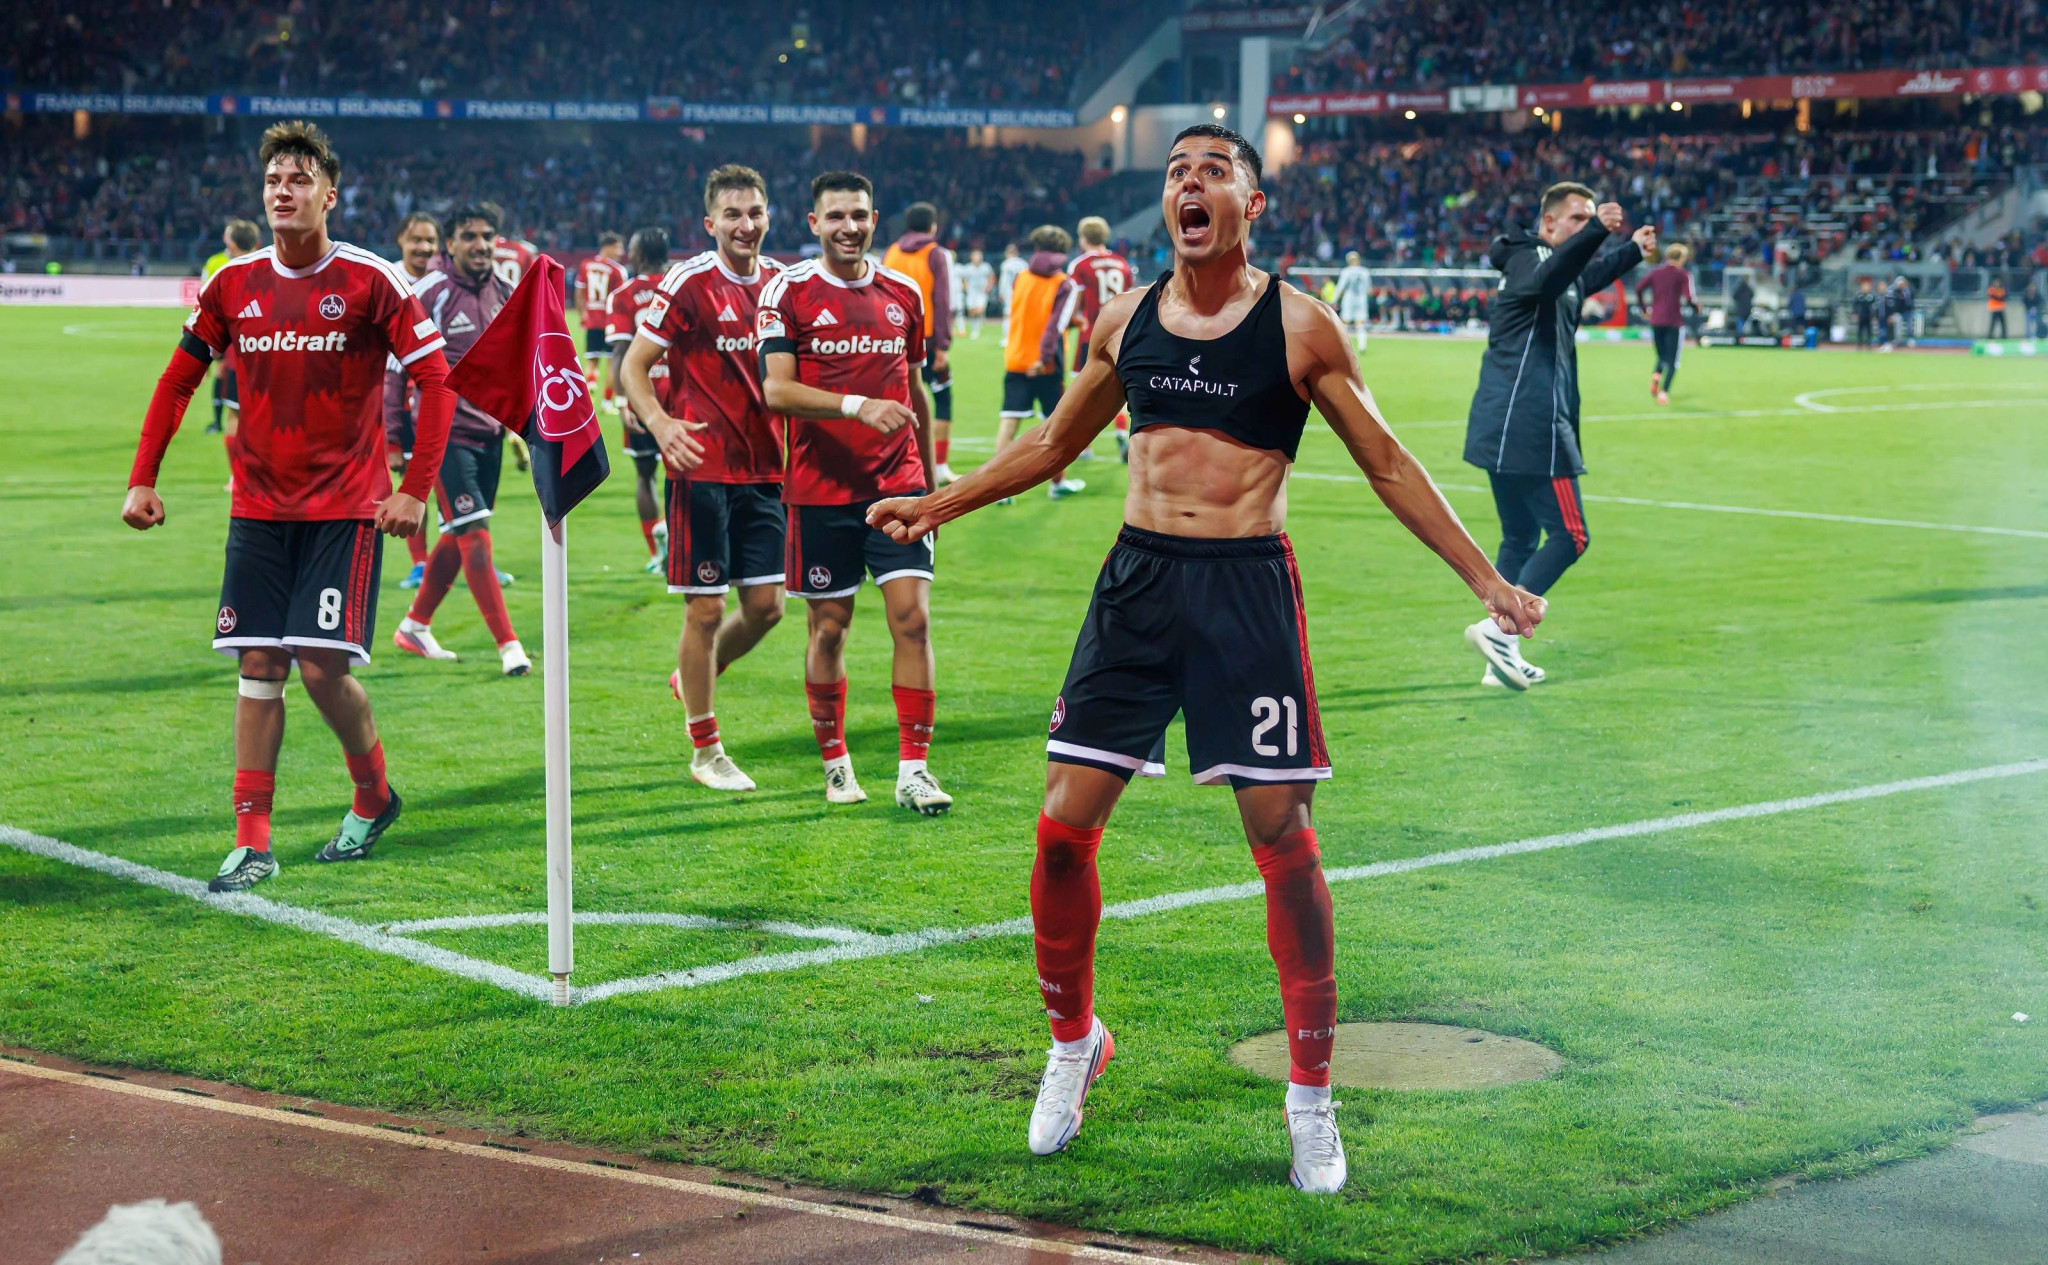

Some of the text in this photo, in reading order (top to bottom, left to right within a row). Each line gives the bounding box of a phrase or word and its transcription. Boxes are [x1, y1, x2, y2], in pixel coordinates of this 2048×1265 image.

[35, 94, 207, 113] FRANKEN BRUNNEN
[251, 96, 422, 116] FRANKEN BRUNNEN
[466, 100, 639, 120] FRANKEN BRUNNEN
[683, 104, 856, 124] FRANKEN BRUNNEN
[902, 107, 1075, 126] FRANKEN BRUNNEN
[1096, 268, 1125, 304] 19
[321, 304, 343, 314] FCN
[239, 331, 347, 353] toolčraft
[716, 332, 756, 351] tool
[1150, 376, 1238, 397] CATAPULT
[317, 587, 342, 630] 8
[218, 617, 234, 627] FCN
[1251, 696, 1297, 756] 21
